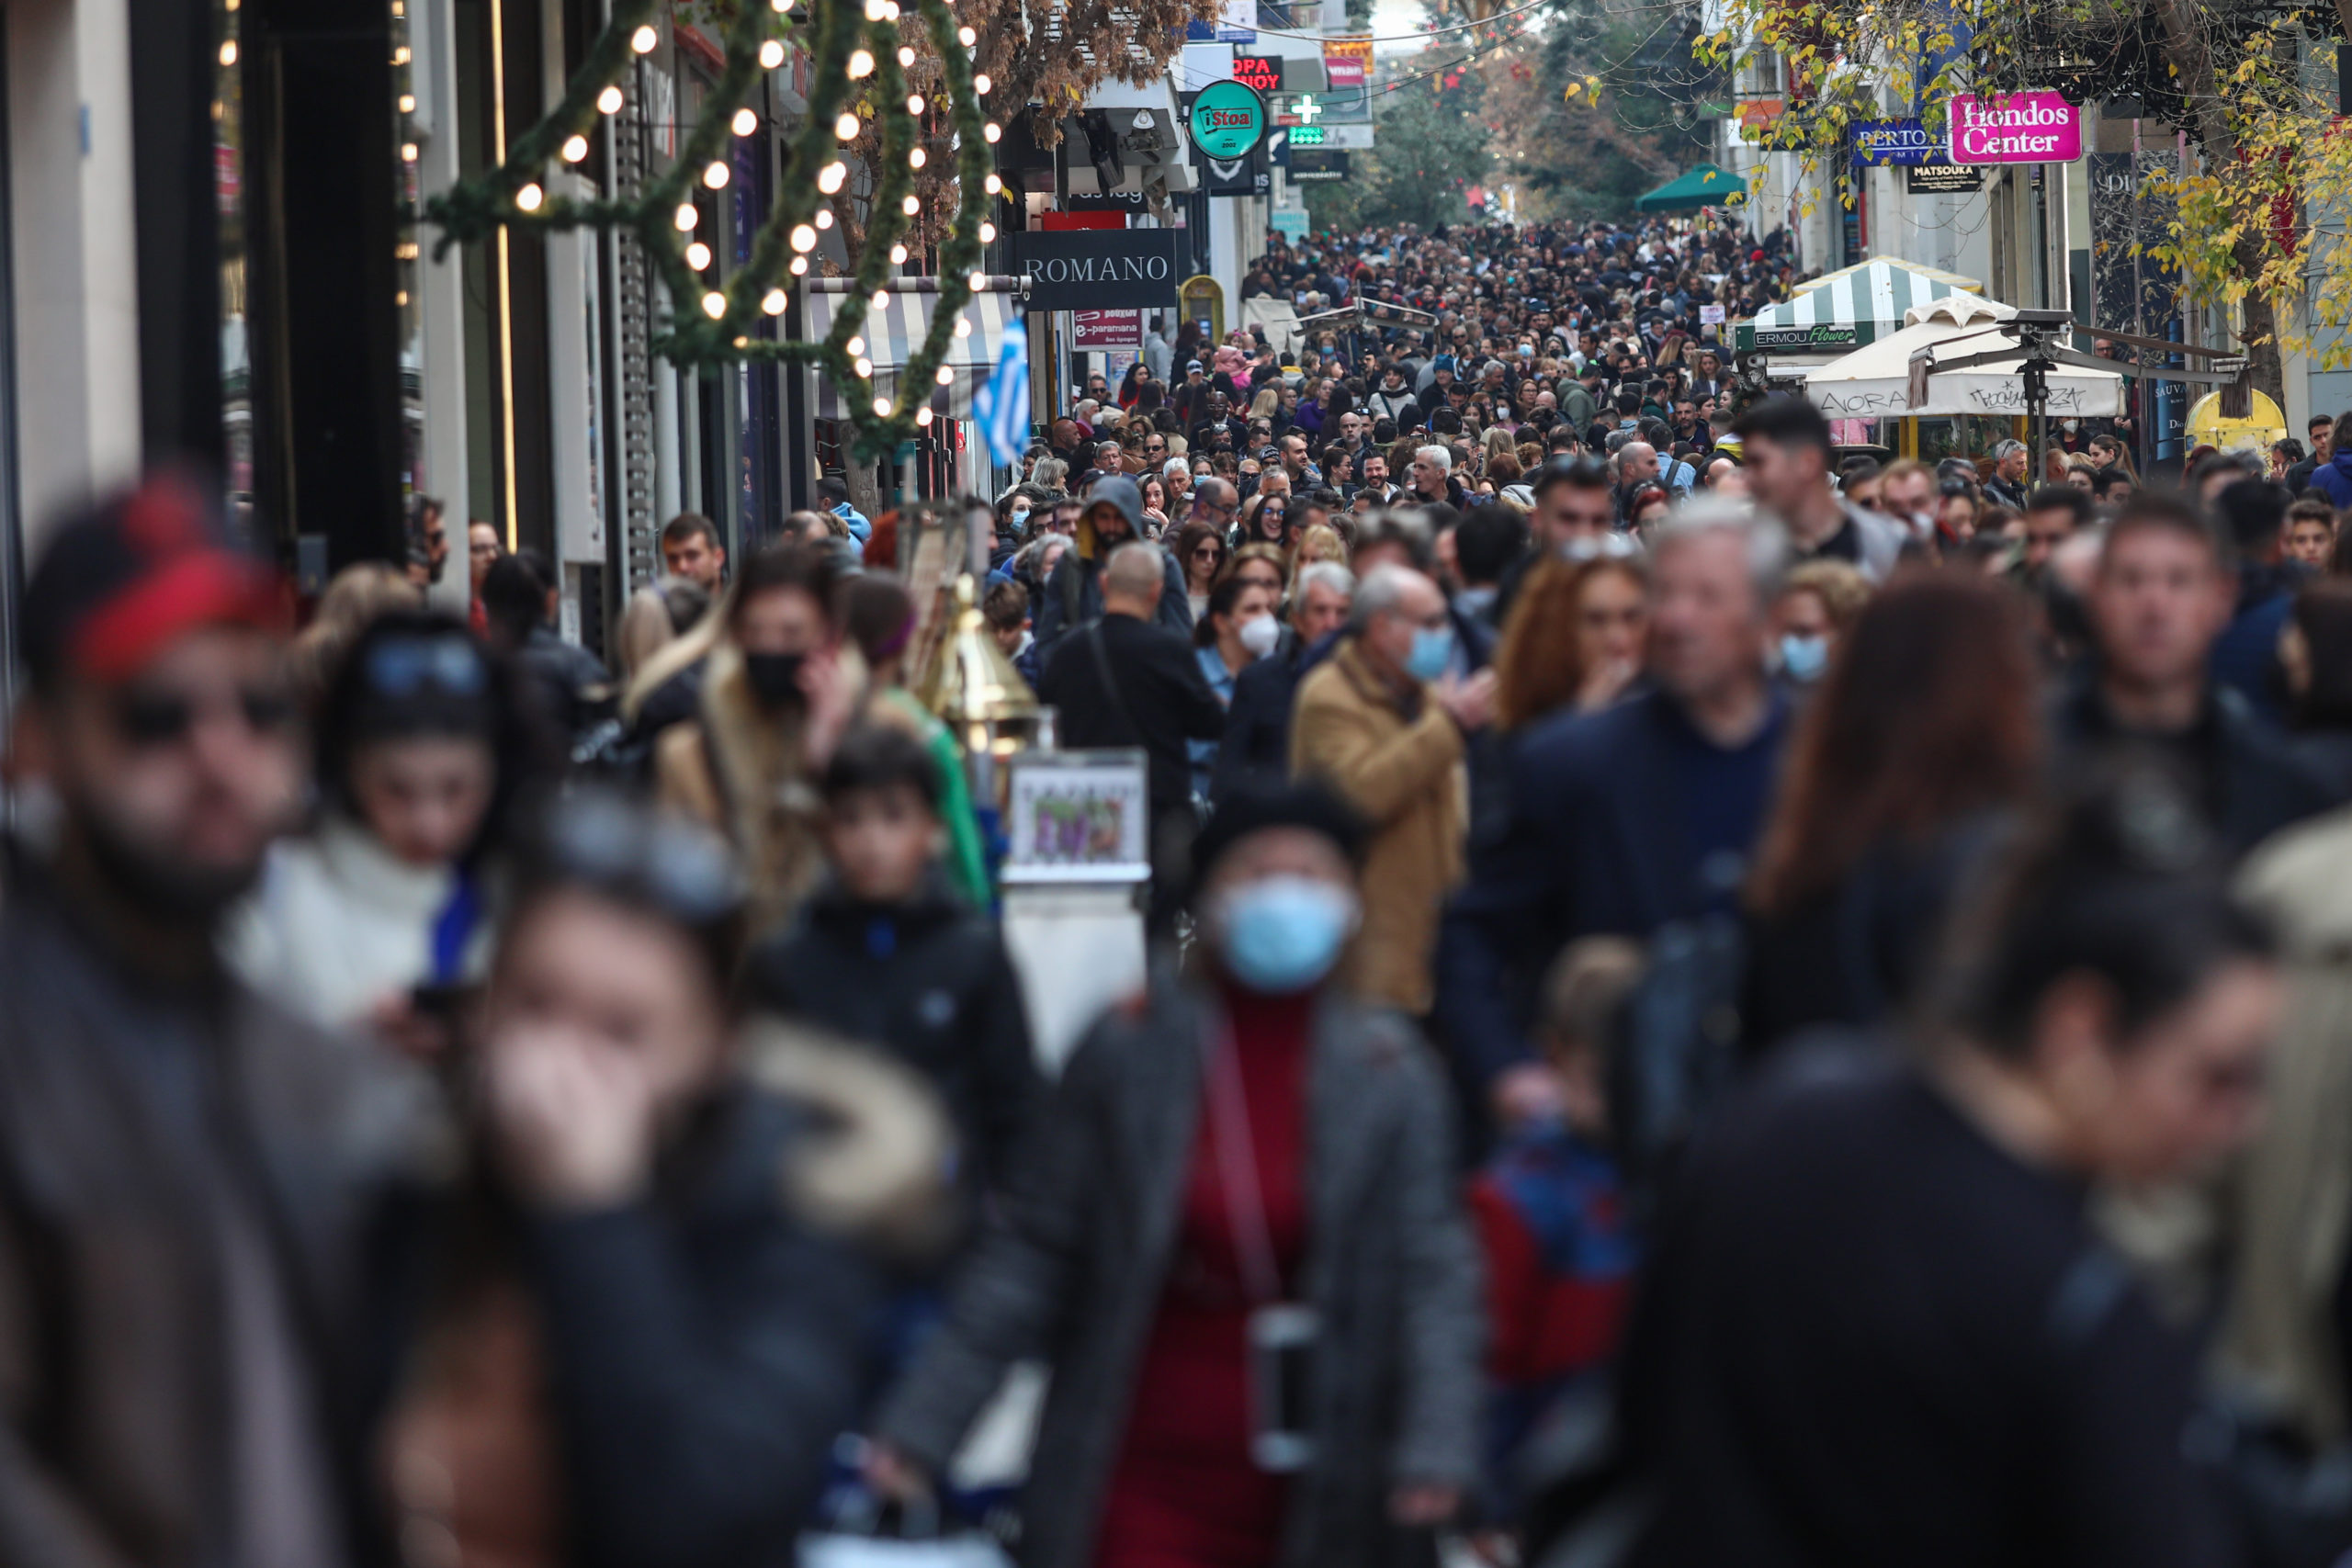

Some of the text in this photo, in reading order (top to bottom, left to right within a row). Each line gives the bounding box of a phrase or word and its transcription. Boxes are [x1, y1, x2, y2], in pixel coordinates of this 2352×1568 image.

[1205, 111, 1250, 127] iStoa
[1962, 100, 2070, 128] Hondos
[1962, 128, 2060, 155] Center
[1913, 166, 1973, 177] MATSOUKA
[1023, 255, 1168, 283] ROMANO
[1075, 324, 1137, 338] e-paramana
[1756, 326, 1854, 344] ERMOU Flower
